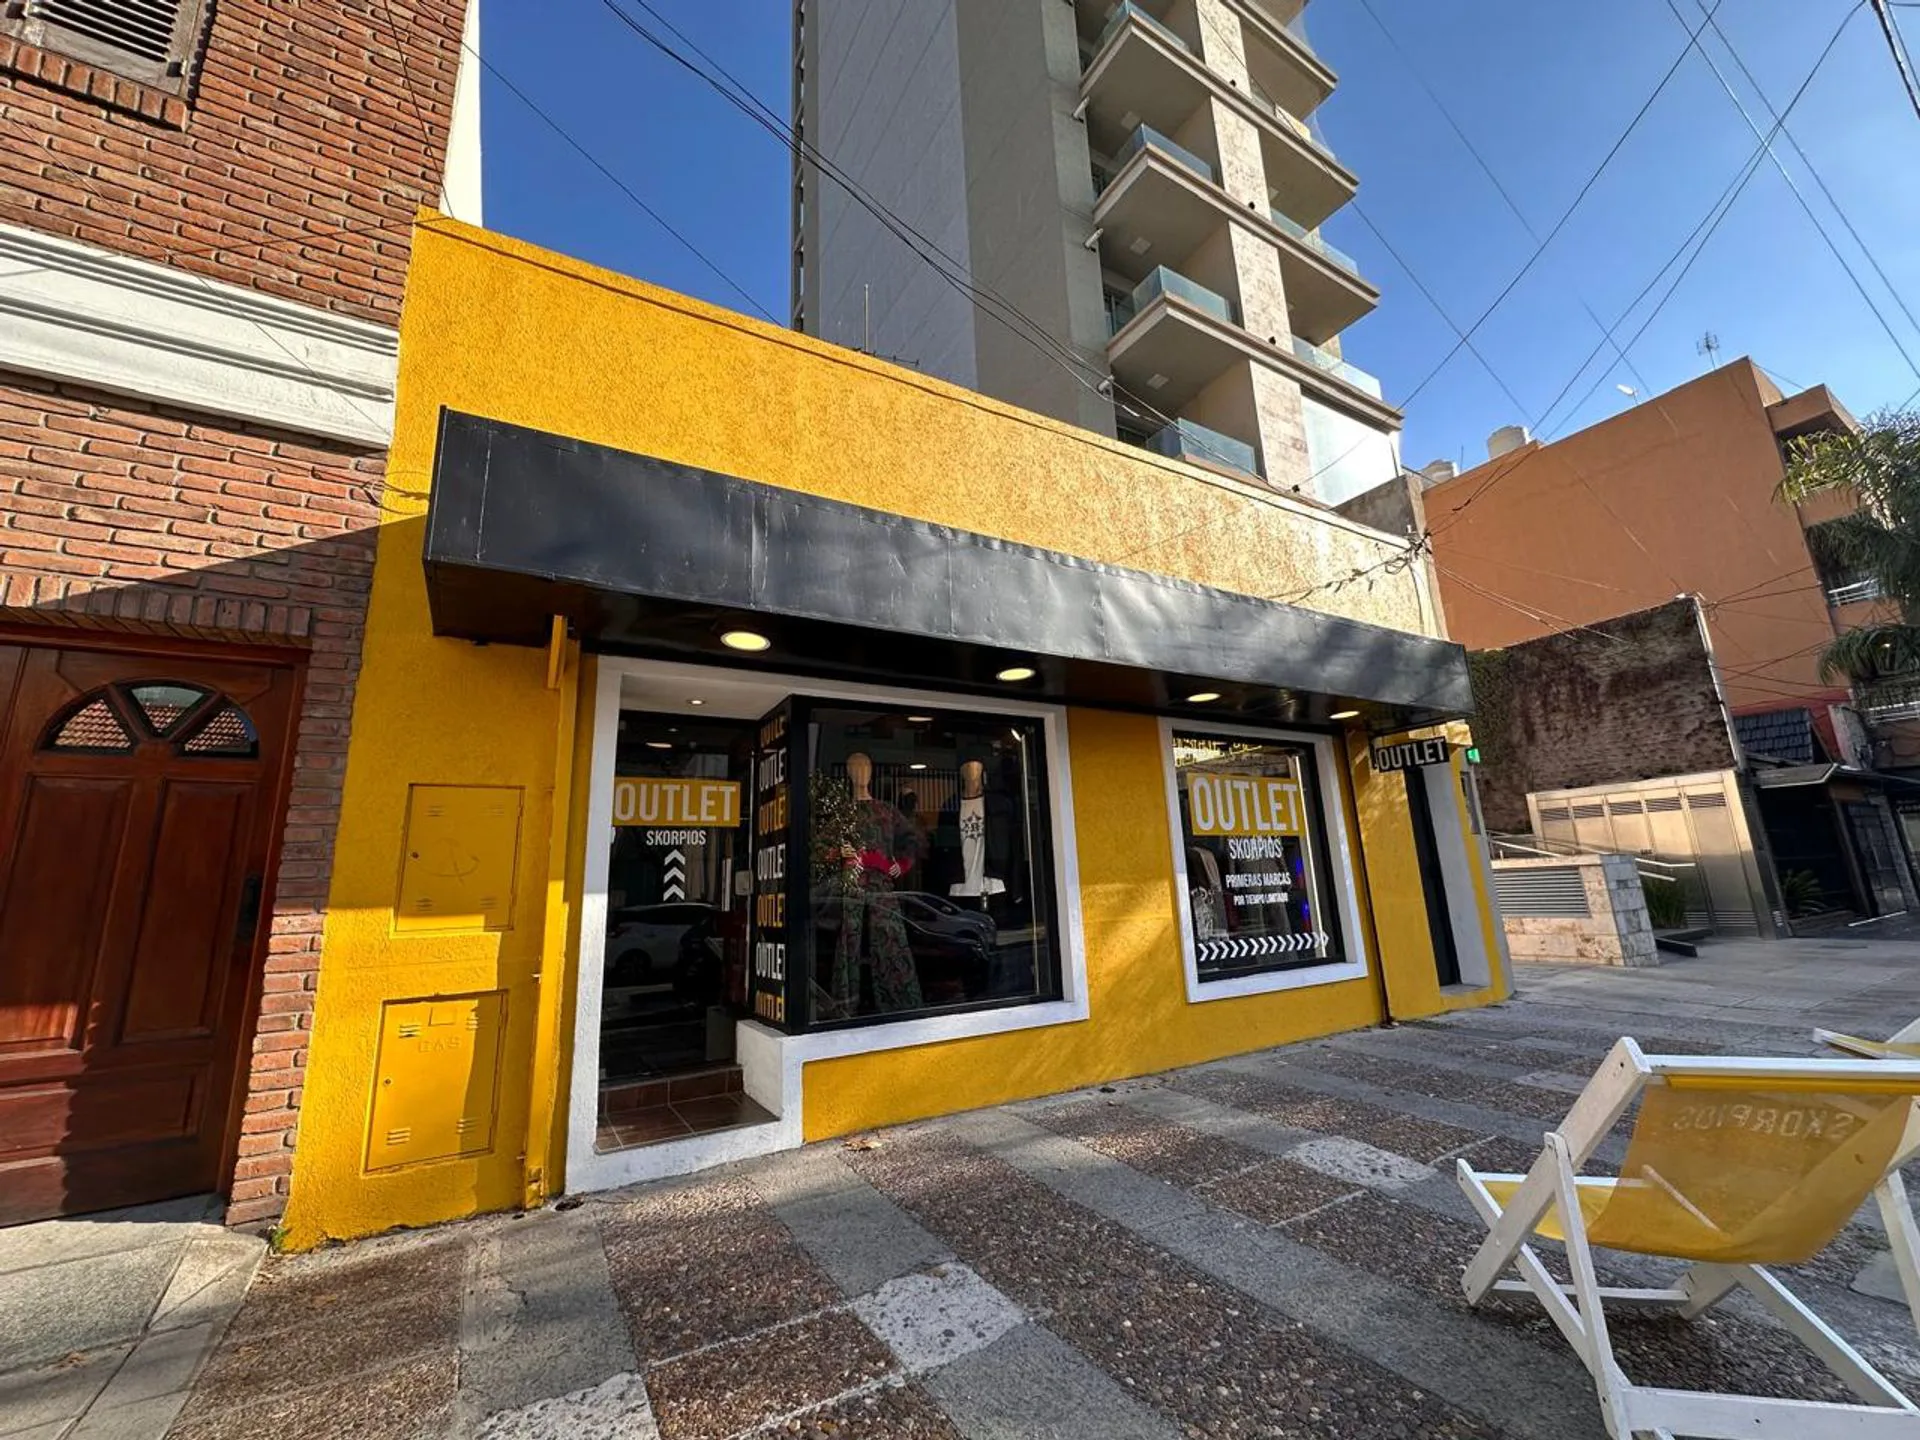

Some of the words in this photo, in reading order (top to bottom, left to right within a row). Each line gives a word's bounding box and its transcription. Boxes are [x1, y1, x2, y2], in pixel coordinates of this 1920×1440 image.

[1379, 738, 1445, 771] OUTLET
[614, 782, 737, 822] OUTLET
[1193, 777, 1299, 831] OUTLET
[646, 830, 707, 846] SKORPIOS
[1228, 836, 1283, 860] SKORPIOS
[1225, 873, 1263, 888] PRIMERAS
[1263, 872, 1292, 886] MARCAS
